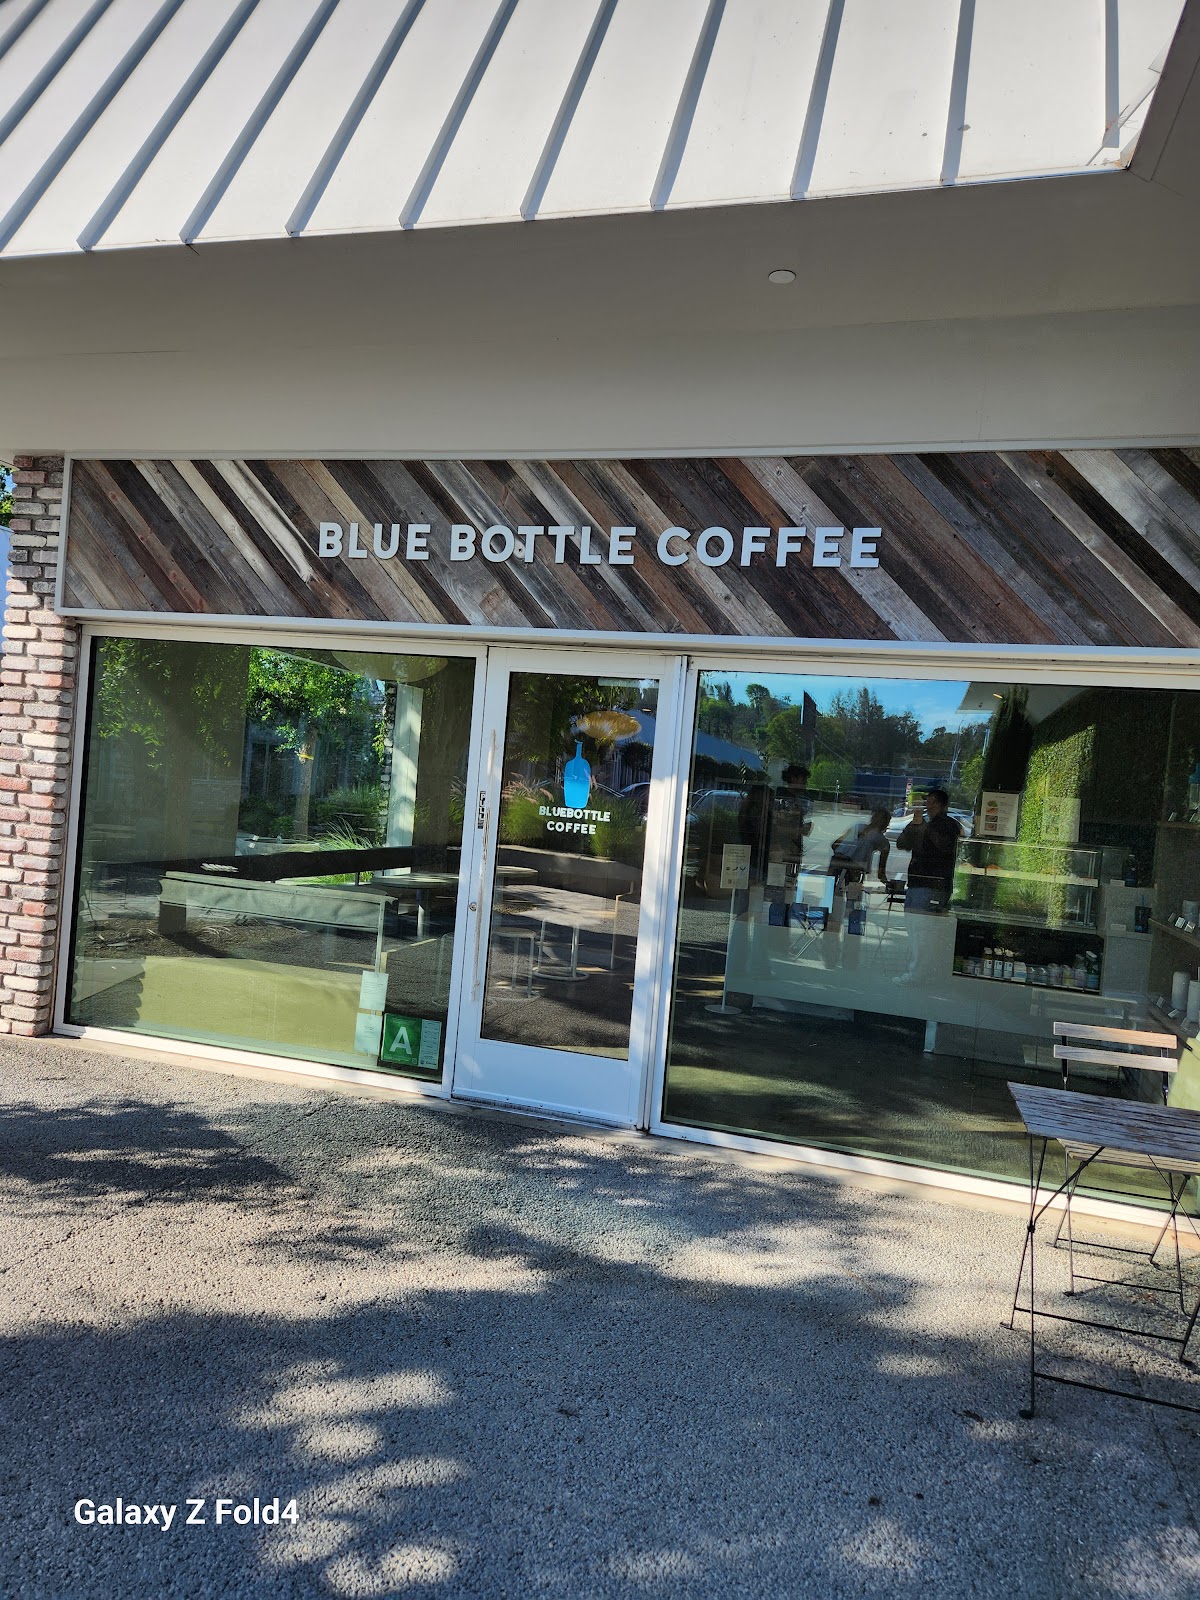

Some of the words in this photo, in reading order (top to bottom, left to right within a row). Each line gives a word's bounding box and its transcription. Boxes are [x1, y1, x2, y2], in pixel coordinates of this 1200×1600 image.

[318, 521, 432, 561] BLUE
[450, 524, 636, 566] BOTTLE
[656, 526, 883, 569] COFFEE
[546, 820, 597, 835] COFFEE
[389, 1026, 413, 1055] A
